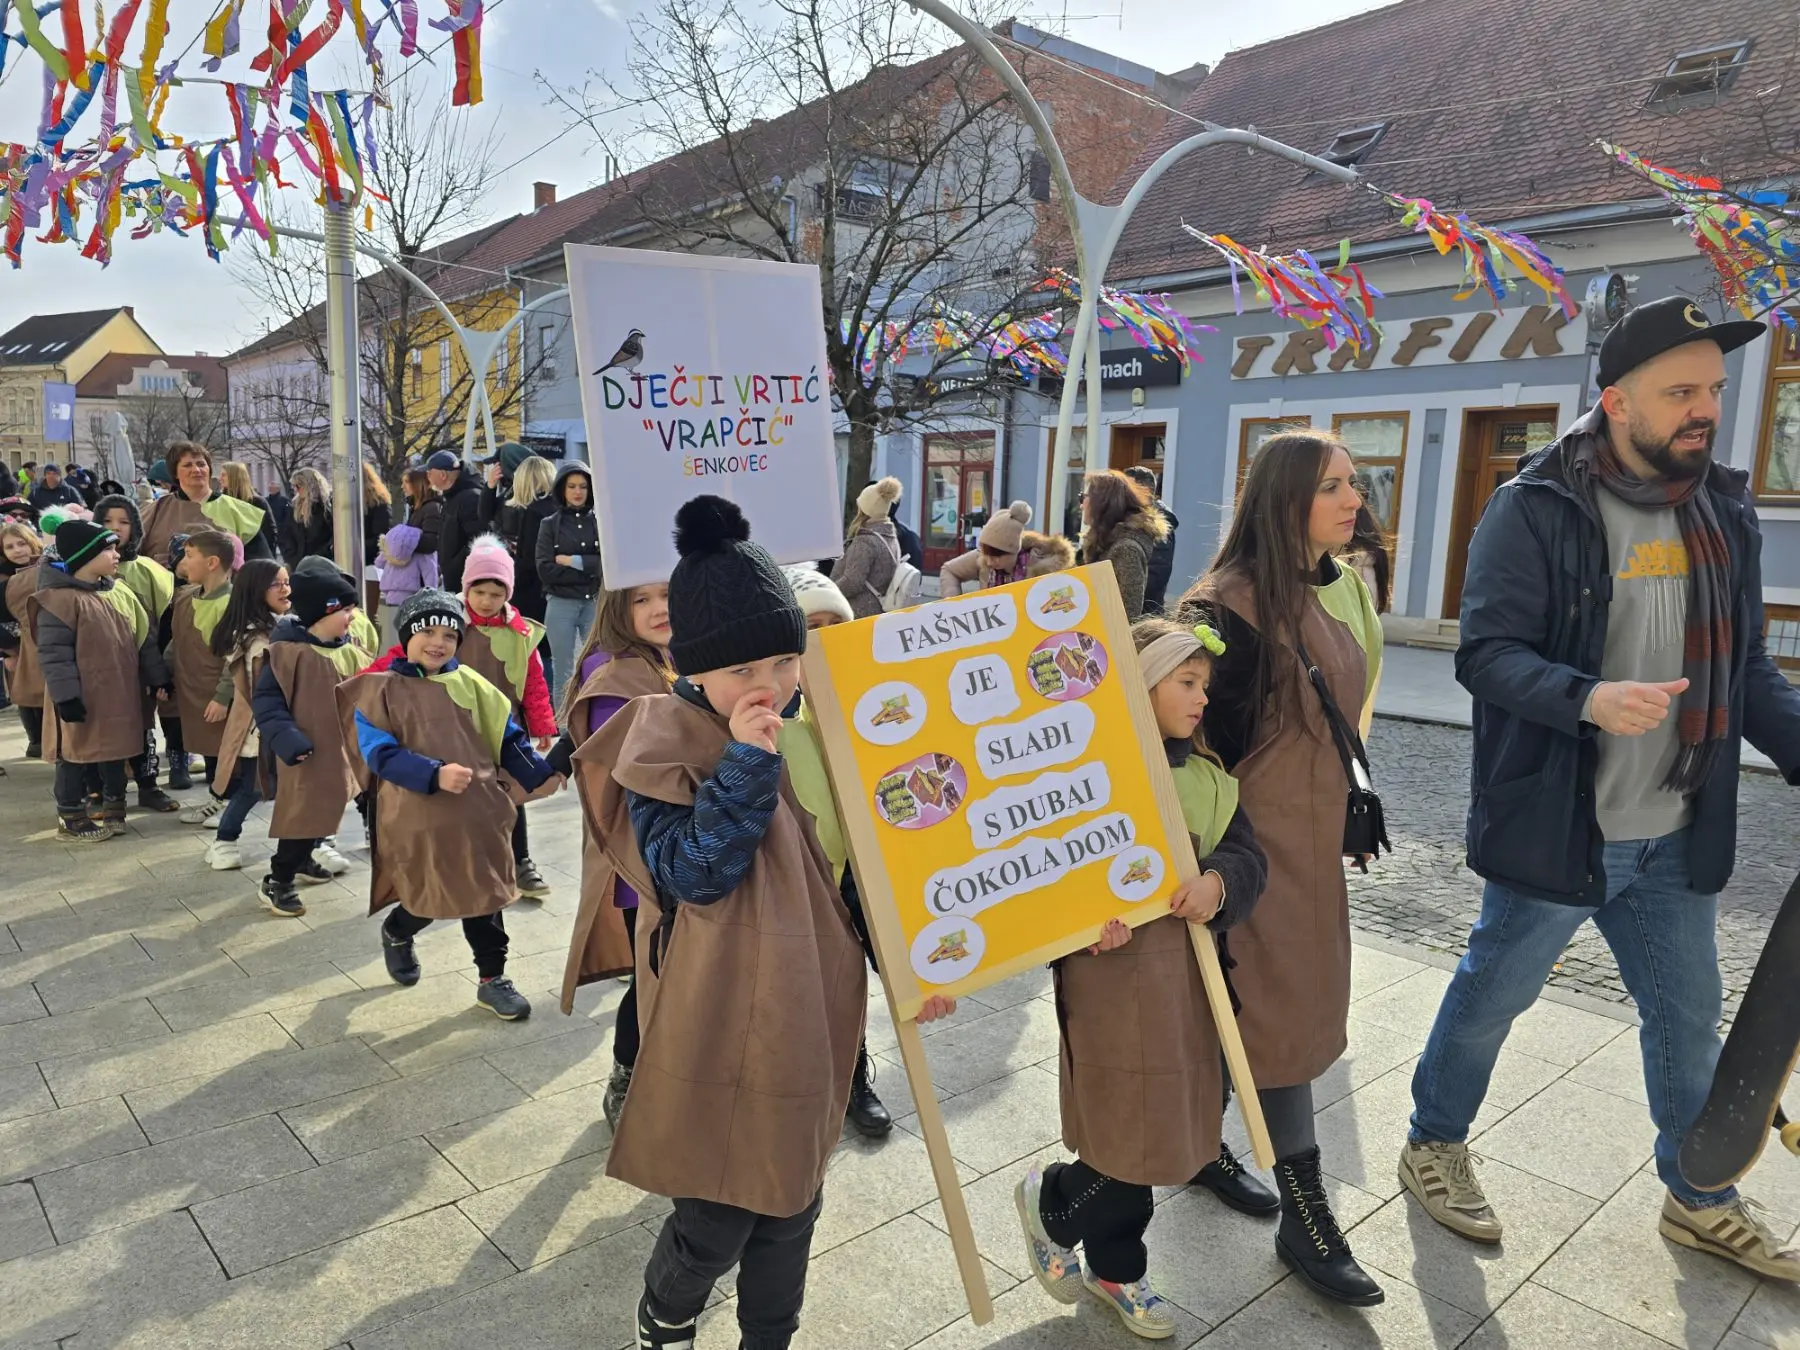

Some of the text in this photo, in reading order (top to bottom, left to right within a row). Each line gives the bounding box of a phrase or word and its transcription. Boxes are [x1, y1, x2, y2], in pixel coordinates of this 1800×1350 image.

[1231, 303, 1582, 379] TRAFIK
[602, 366, 820, 410] DJEČJI VRTIĆ
[643, 407, 793, 451] "VRAPČIĆ"
[683, 455, 768, 476] ŠENKOVEC
[897, 604, 1006, 653] FAŠNIK
[965, 667, 998, 697] JE
[987, 722, 1074, 765] SLAĐI
[984, 778, 1096, 839] S DUBAI
